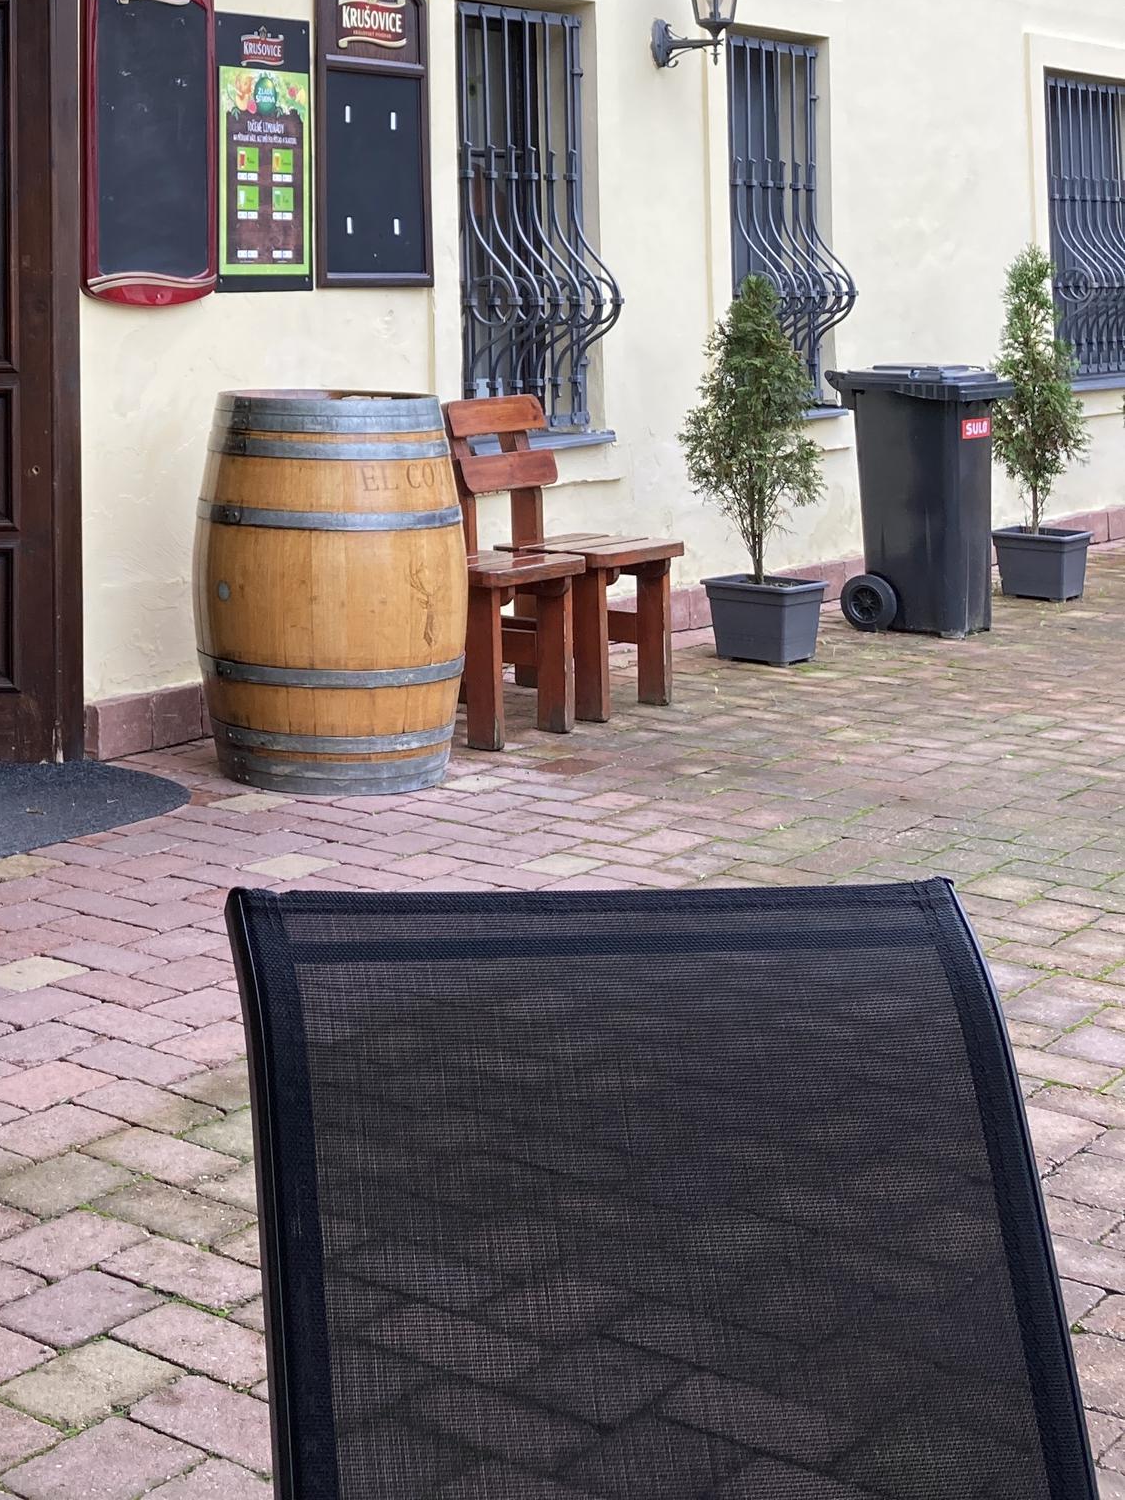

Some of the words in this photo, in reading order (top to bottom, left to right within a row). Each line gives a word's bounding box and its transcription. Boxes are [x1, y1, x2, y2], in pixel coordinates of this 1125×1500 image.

[342, 5, 403, 33] KRUŠOVICE
[243, 41, 282, 57] KRUŠOVICE
[965, 420, 988, 436] SULO
[361, 464, 399, 492] EL
